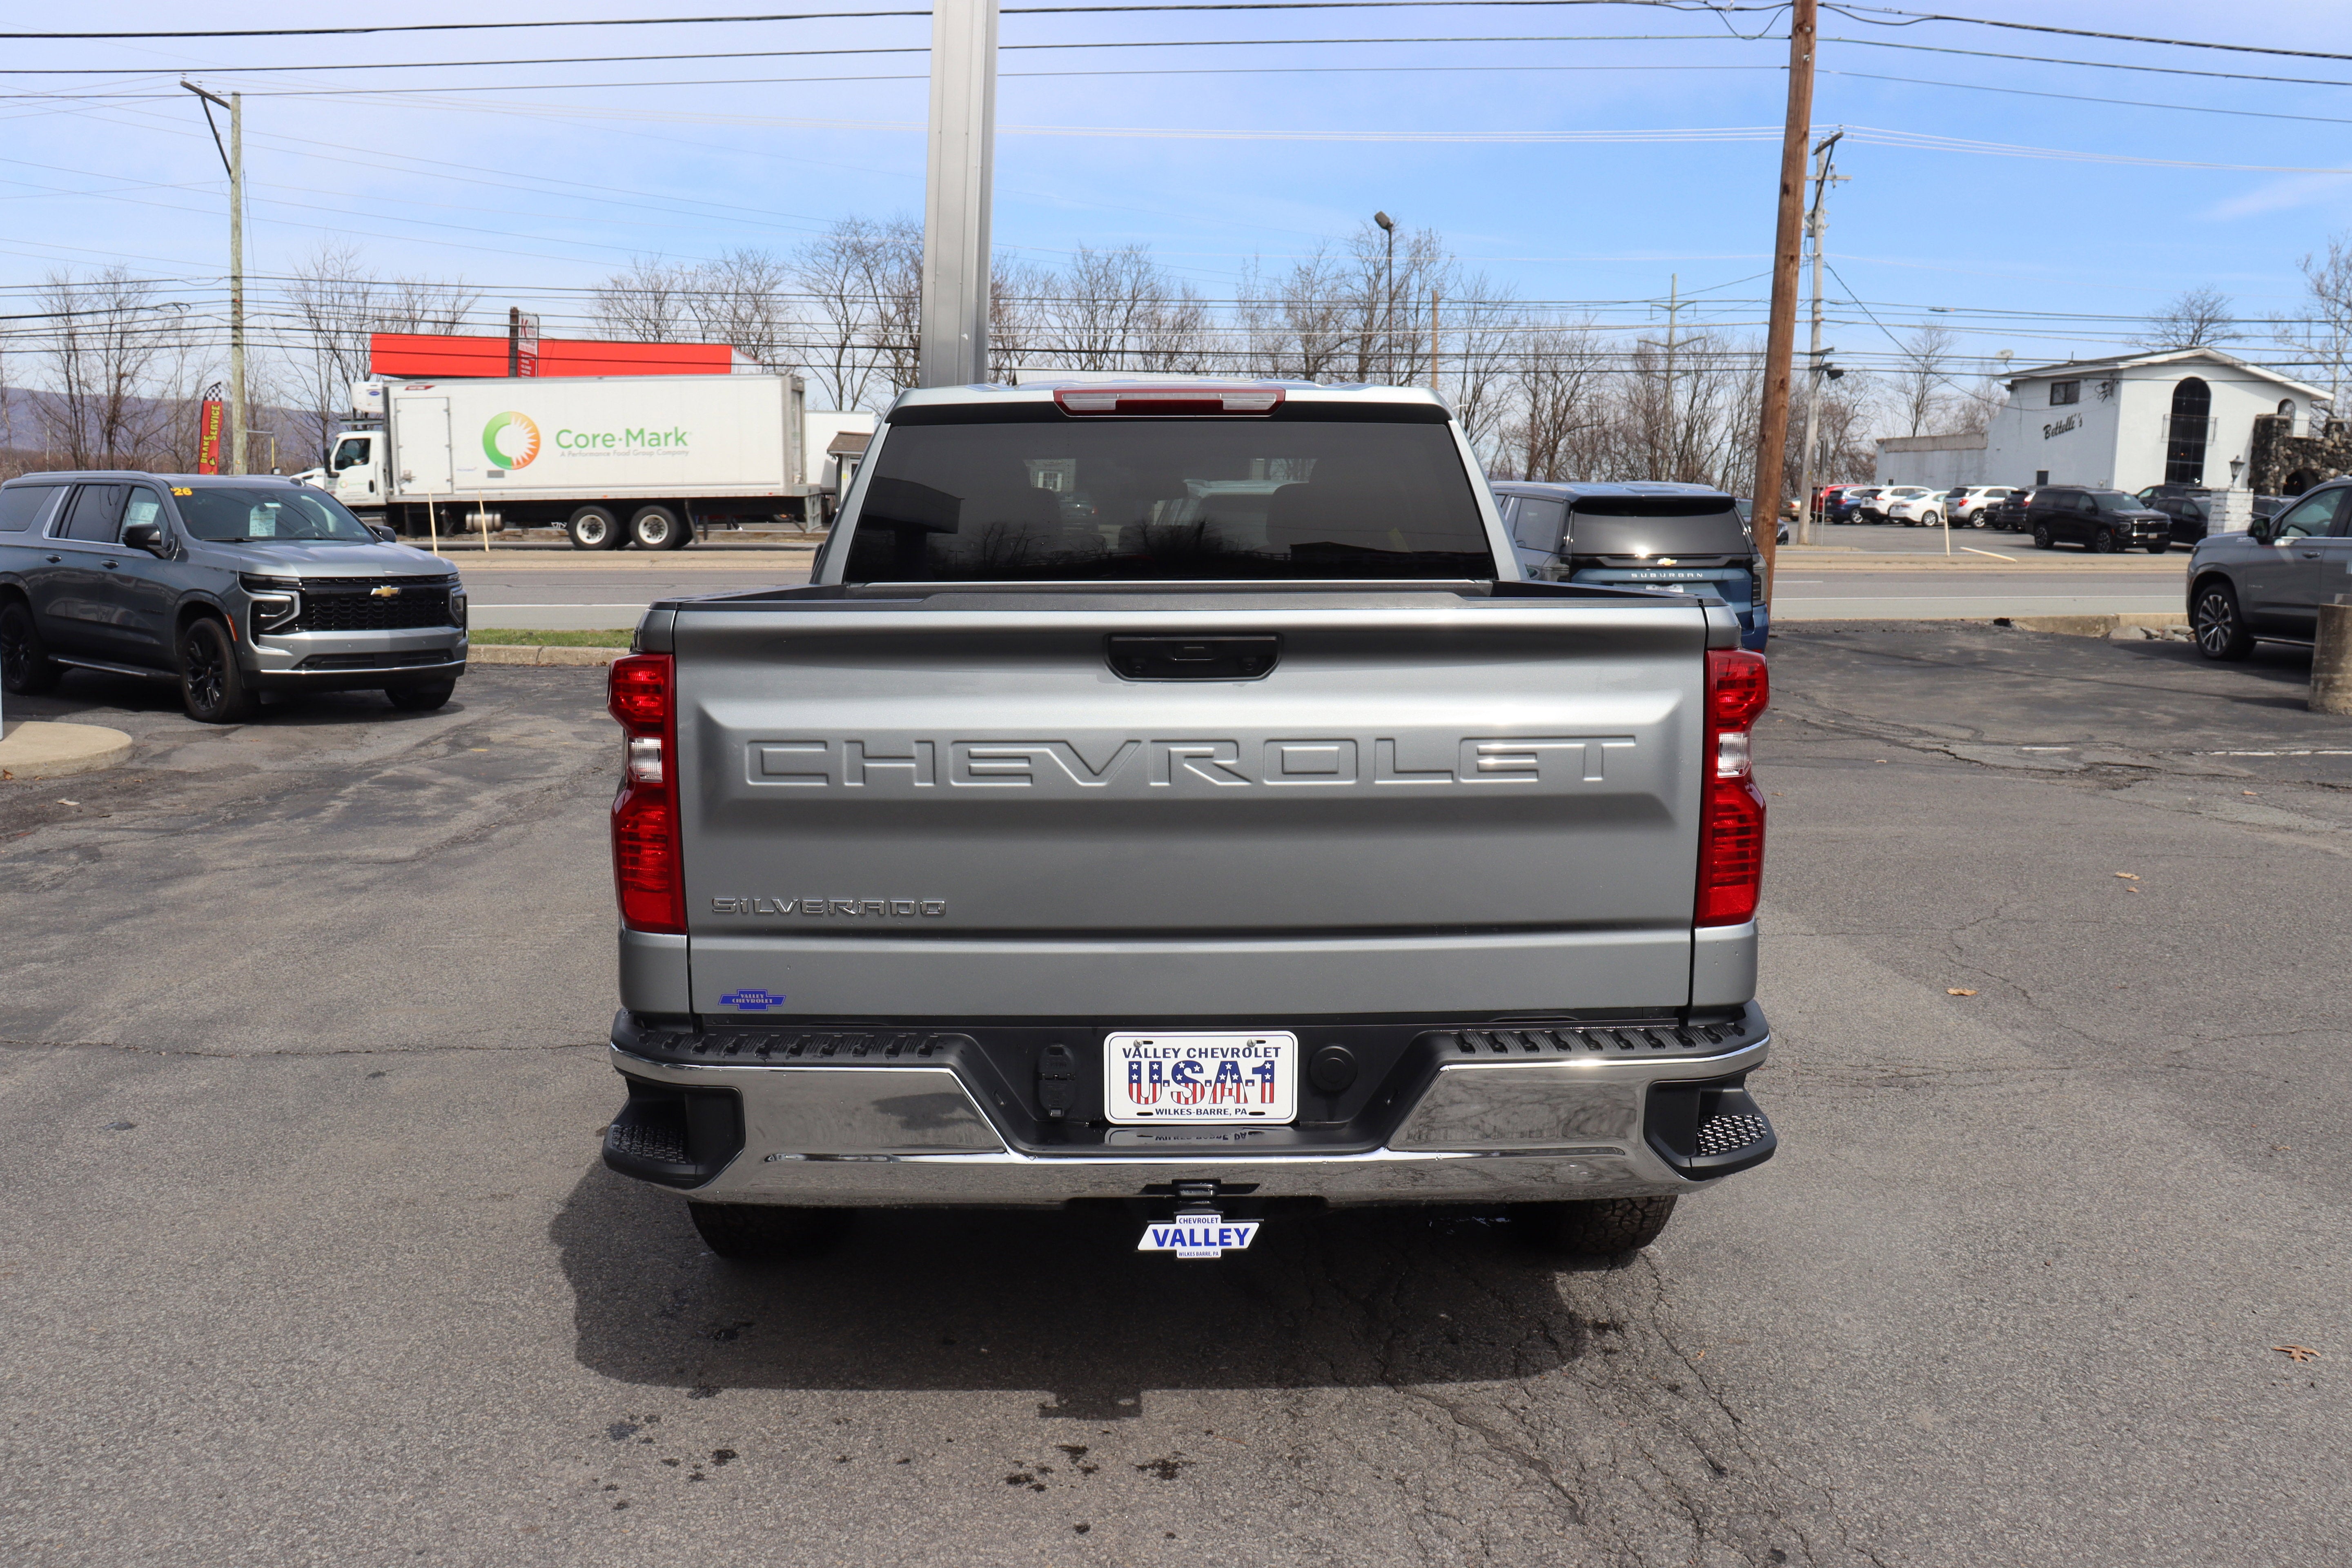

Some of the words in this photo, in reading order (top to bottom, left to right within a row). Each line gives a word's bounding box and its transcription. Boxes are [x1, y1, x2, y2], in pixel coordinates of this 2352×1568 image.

[210, 405, 220, 440] SERVICE
[200, 435, 209, 463] BRAKE
[746, 735, 1636, 786] CHEVROLET
[712, 898, 946, 915] SILVERADO
[1123, 1048, 1181, 1058] VALLEY
[1187, 1047, 1281, 1058] CHEVROLET
[1155, 1108, 1232, 1116] WILKES-BARRE,
[1152, 1228, 1250, 1247] VALLEY
